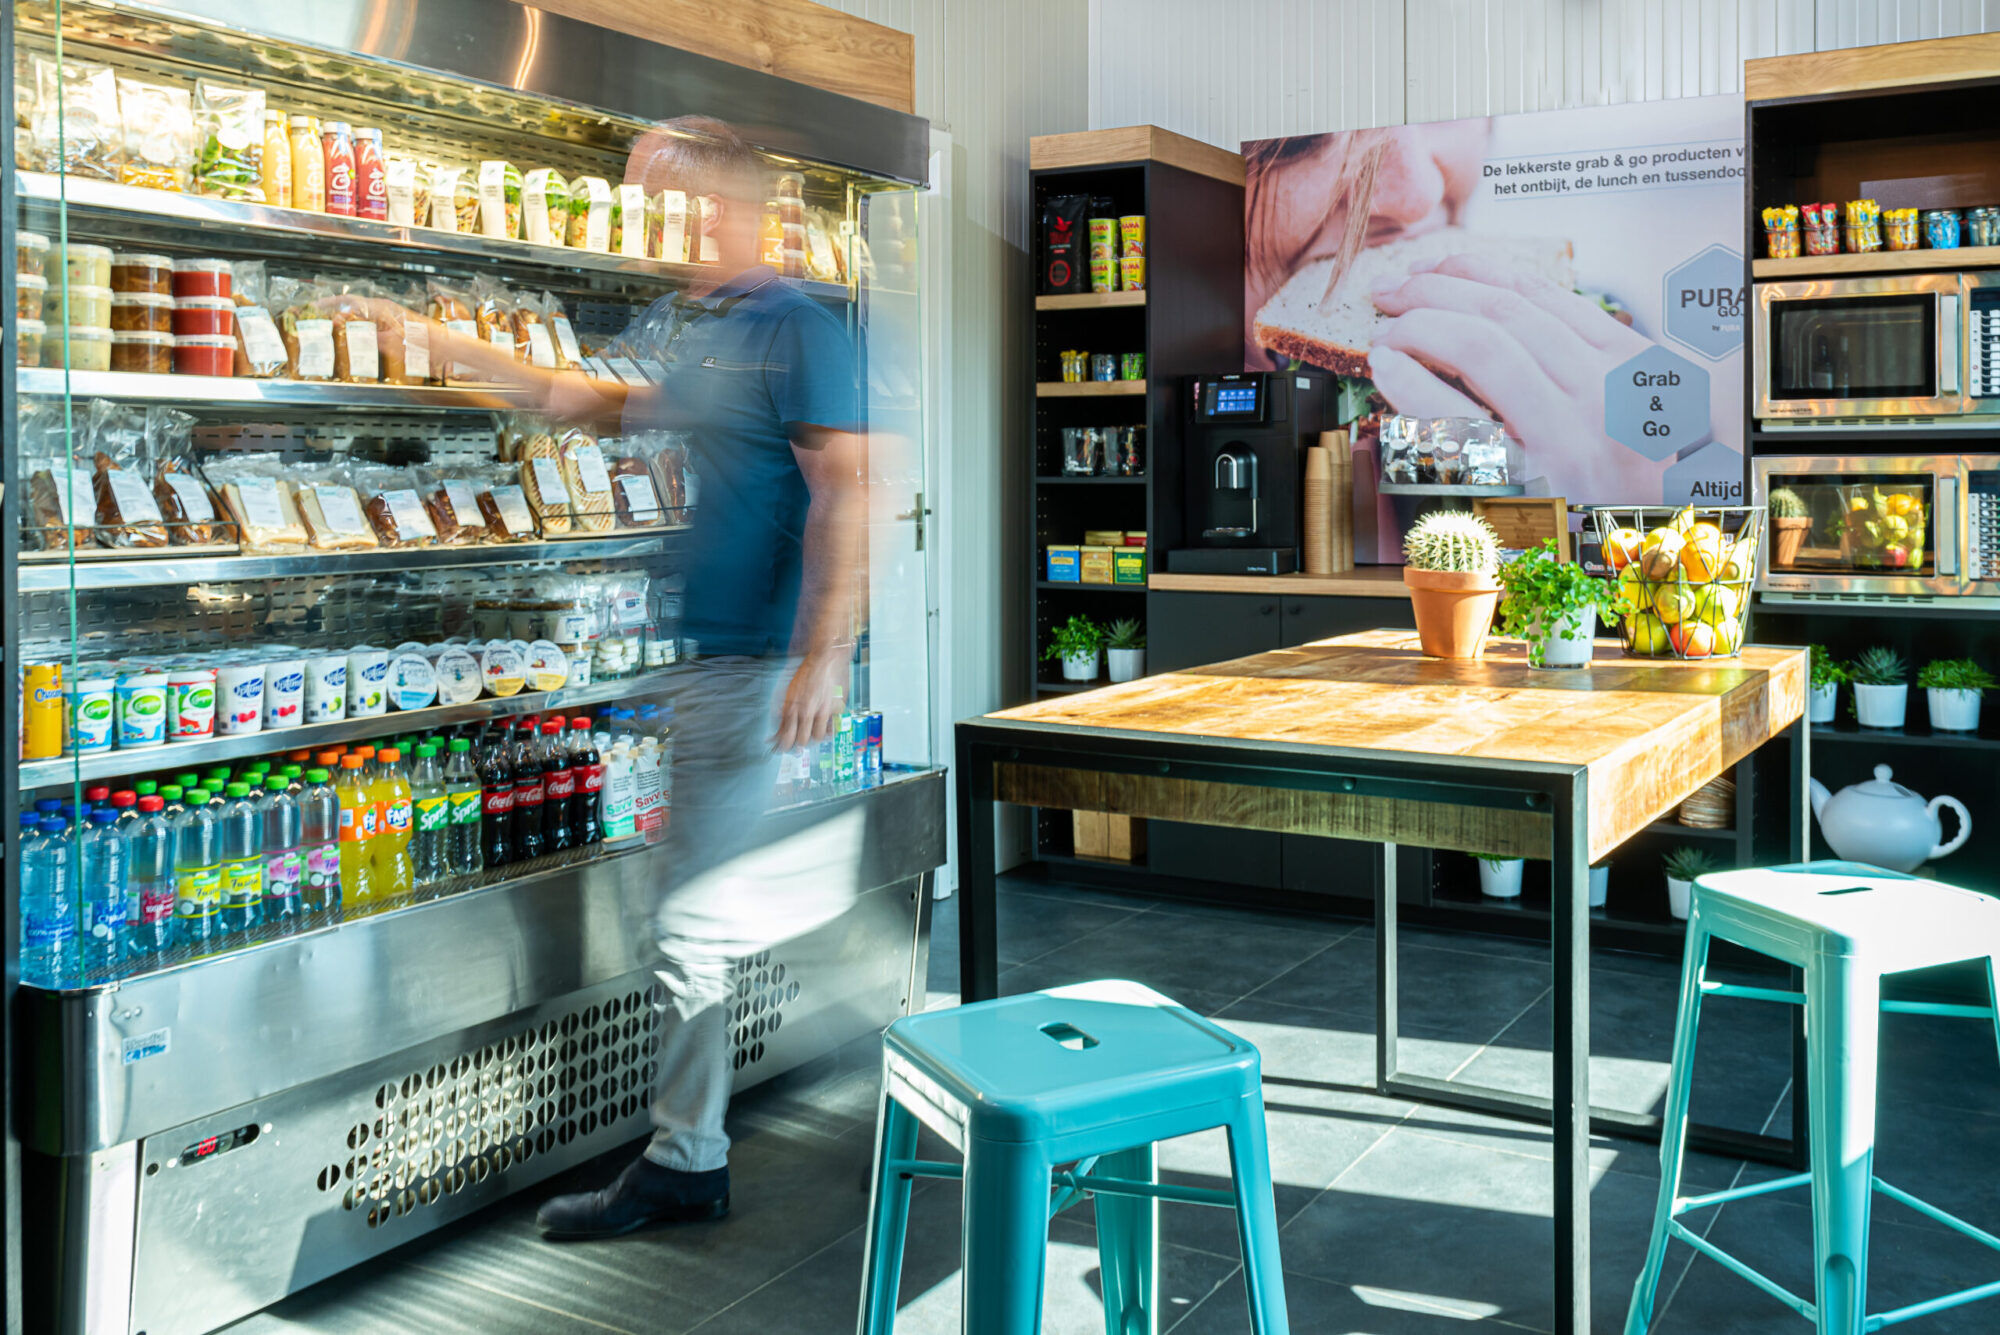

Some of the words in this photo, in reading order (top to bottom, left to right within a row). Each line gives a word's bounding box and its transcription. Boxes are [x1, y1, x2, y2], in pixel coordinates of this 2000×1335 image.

[1483, 164, 1502, 177] De
[1505, 160, 1571, 176] lekkerste
[1576, 155, 1609, 173] grab
[1613, 154, 1624, 167] &
[1629, 153, 1648, 169] go
[1652, 146, 1731, 167] producten
[1494, 183, 1517, 195] het
[1521, 178, 1570, 194] ontbijt,
[1575, 176, 1593, 189] de
[1597, 173, 1637, 188] lunch
[1642, 173, 1660, 184] en
[1633, 371, 1681, 387] Grab
[1649, 395, 1663, 411] &
[1643, 420, 1671, 437] Go
[1690, 481, 1742, 500] Altijd
